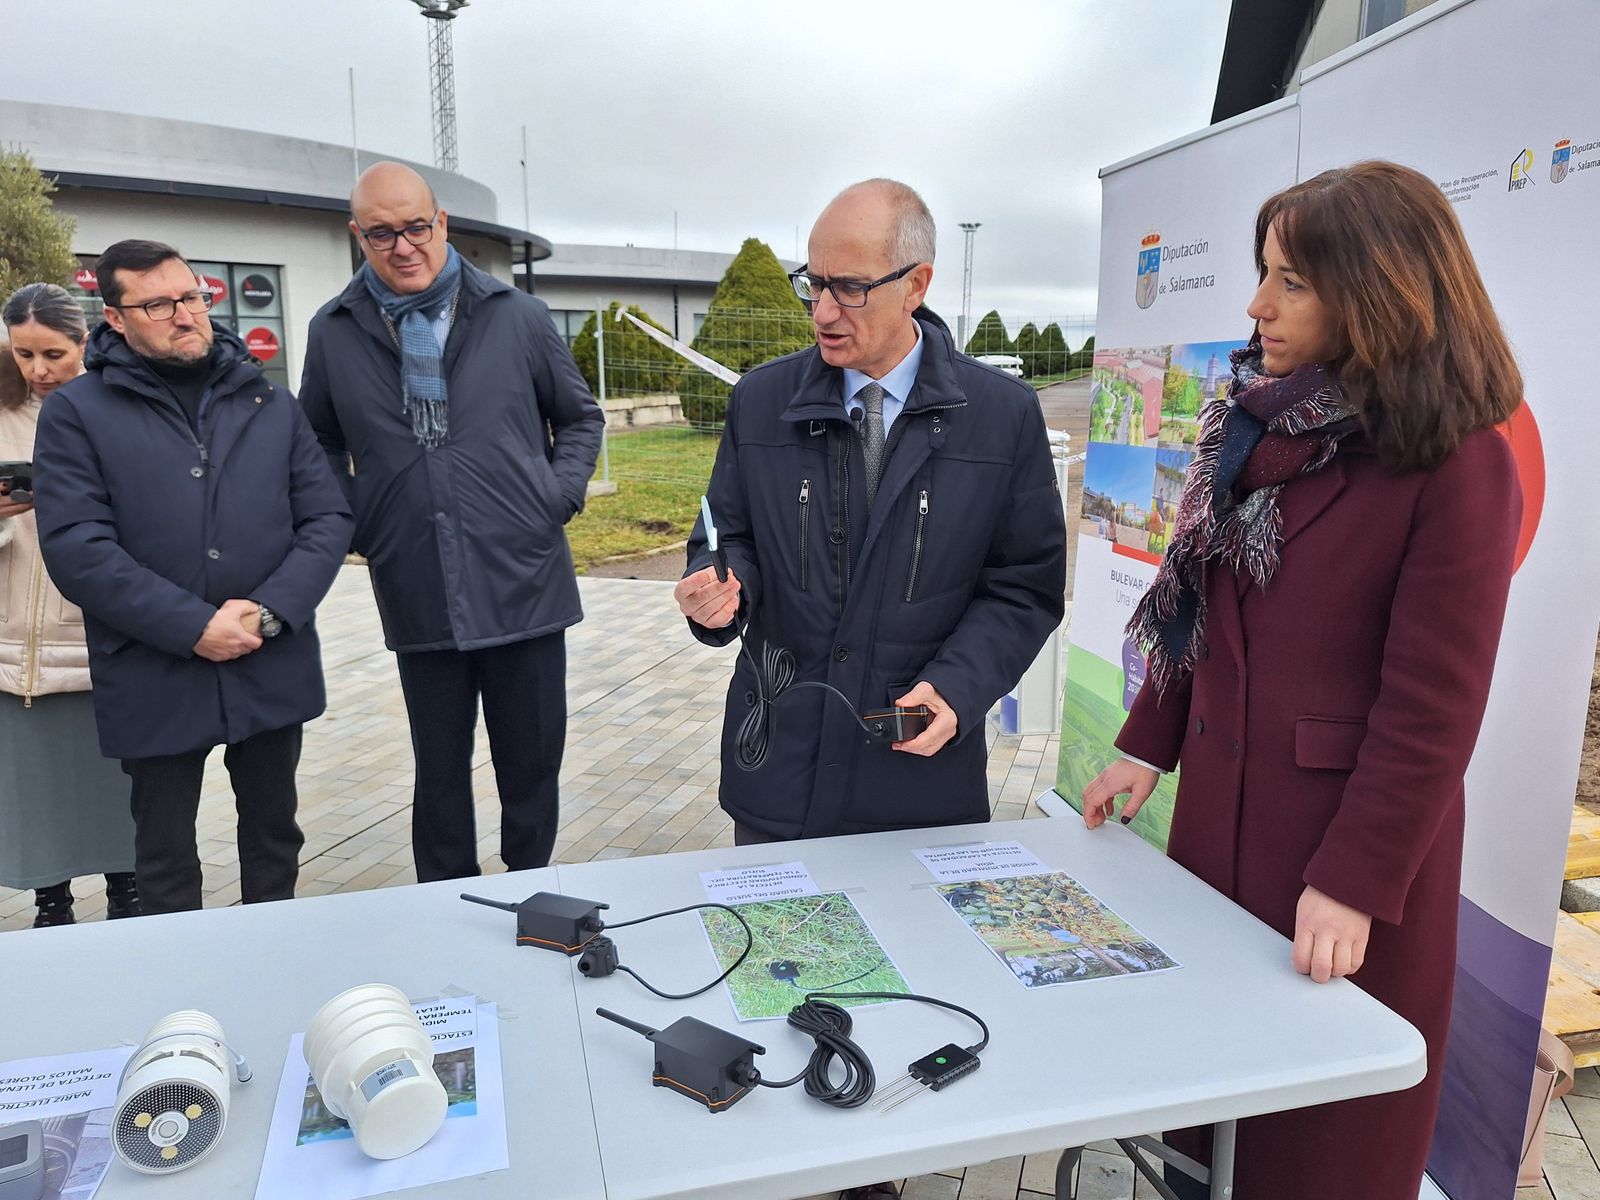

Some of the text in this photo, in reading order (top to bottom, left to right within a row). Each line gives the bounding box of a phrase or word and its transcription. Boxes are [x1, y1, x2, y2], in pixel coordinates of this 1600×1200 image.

[1511, 178, 1528, 191] PIREP
[1162, 238, 1209, 263] Diputación
[1159, 274, 1215, 294] de Salamanca
[1110, 569, 1144, 591] BULEVAR
[1116, 588, 1131, 607] Una
[727, 871, 783, 882] TEMPERATURA
[748, 880, 783, 888] DETECTA
[726, 893, 752, 901] SUELO
[769, 888, 804, 897] CALIDAD
[48, 1067, 93, 1080] MALOS
[59, 1072, 113, 1086] DETECTA
[38, 1081, 55, 1089] DE
[54, 1090, 93, 1103] NARIZ
